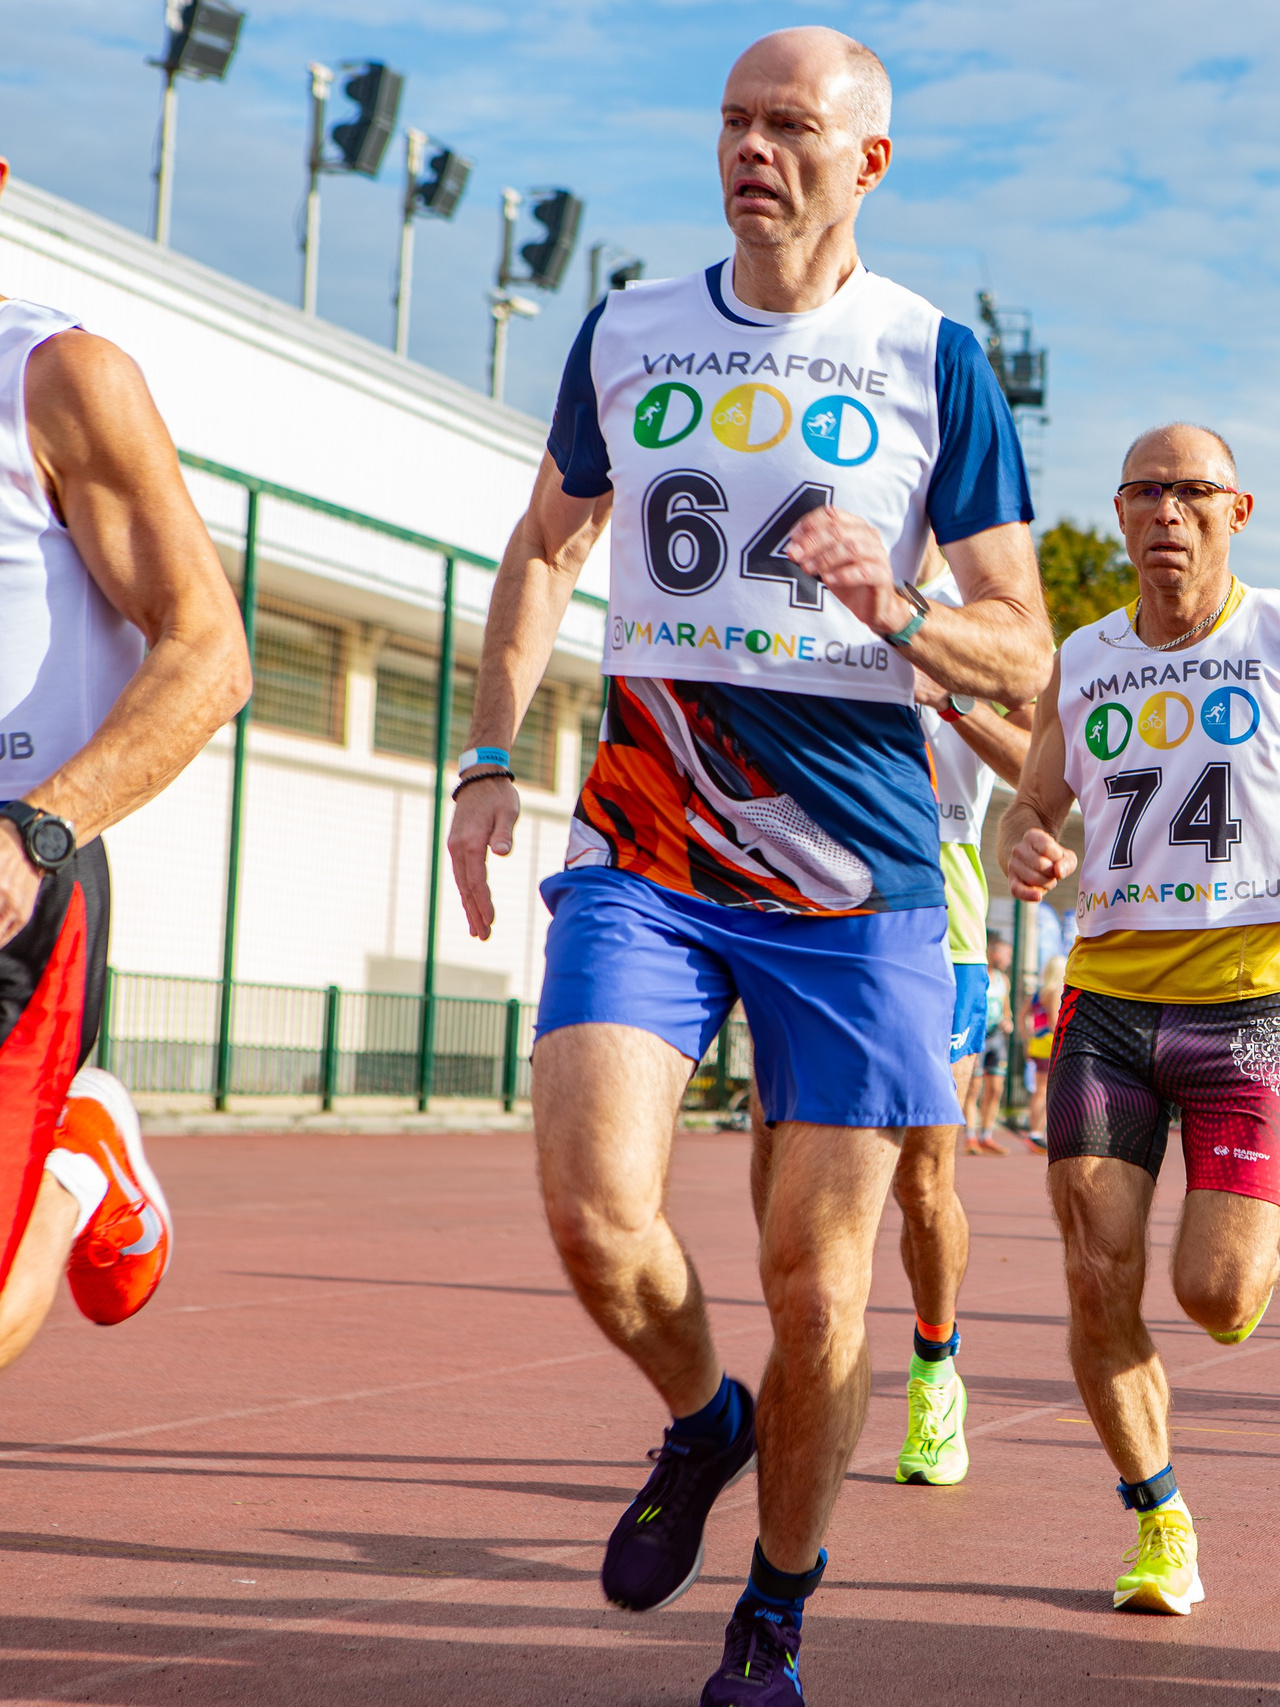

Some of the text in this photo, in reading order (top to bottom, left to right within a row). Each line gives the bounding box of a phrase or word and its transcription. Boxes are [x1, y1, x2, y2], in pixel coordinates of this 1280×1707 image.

[642, 352, 888, 396] VMARAFONE
[642, 468, 835, 612] 64
[1080, 659, 1262, 702] VMARAFONE
[1104, 762, 1242, 870] 74
